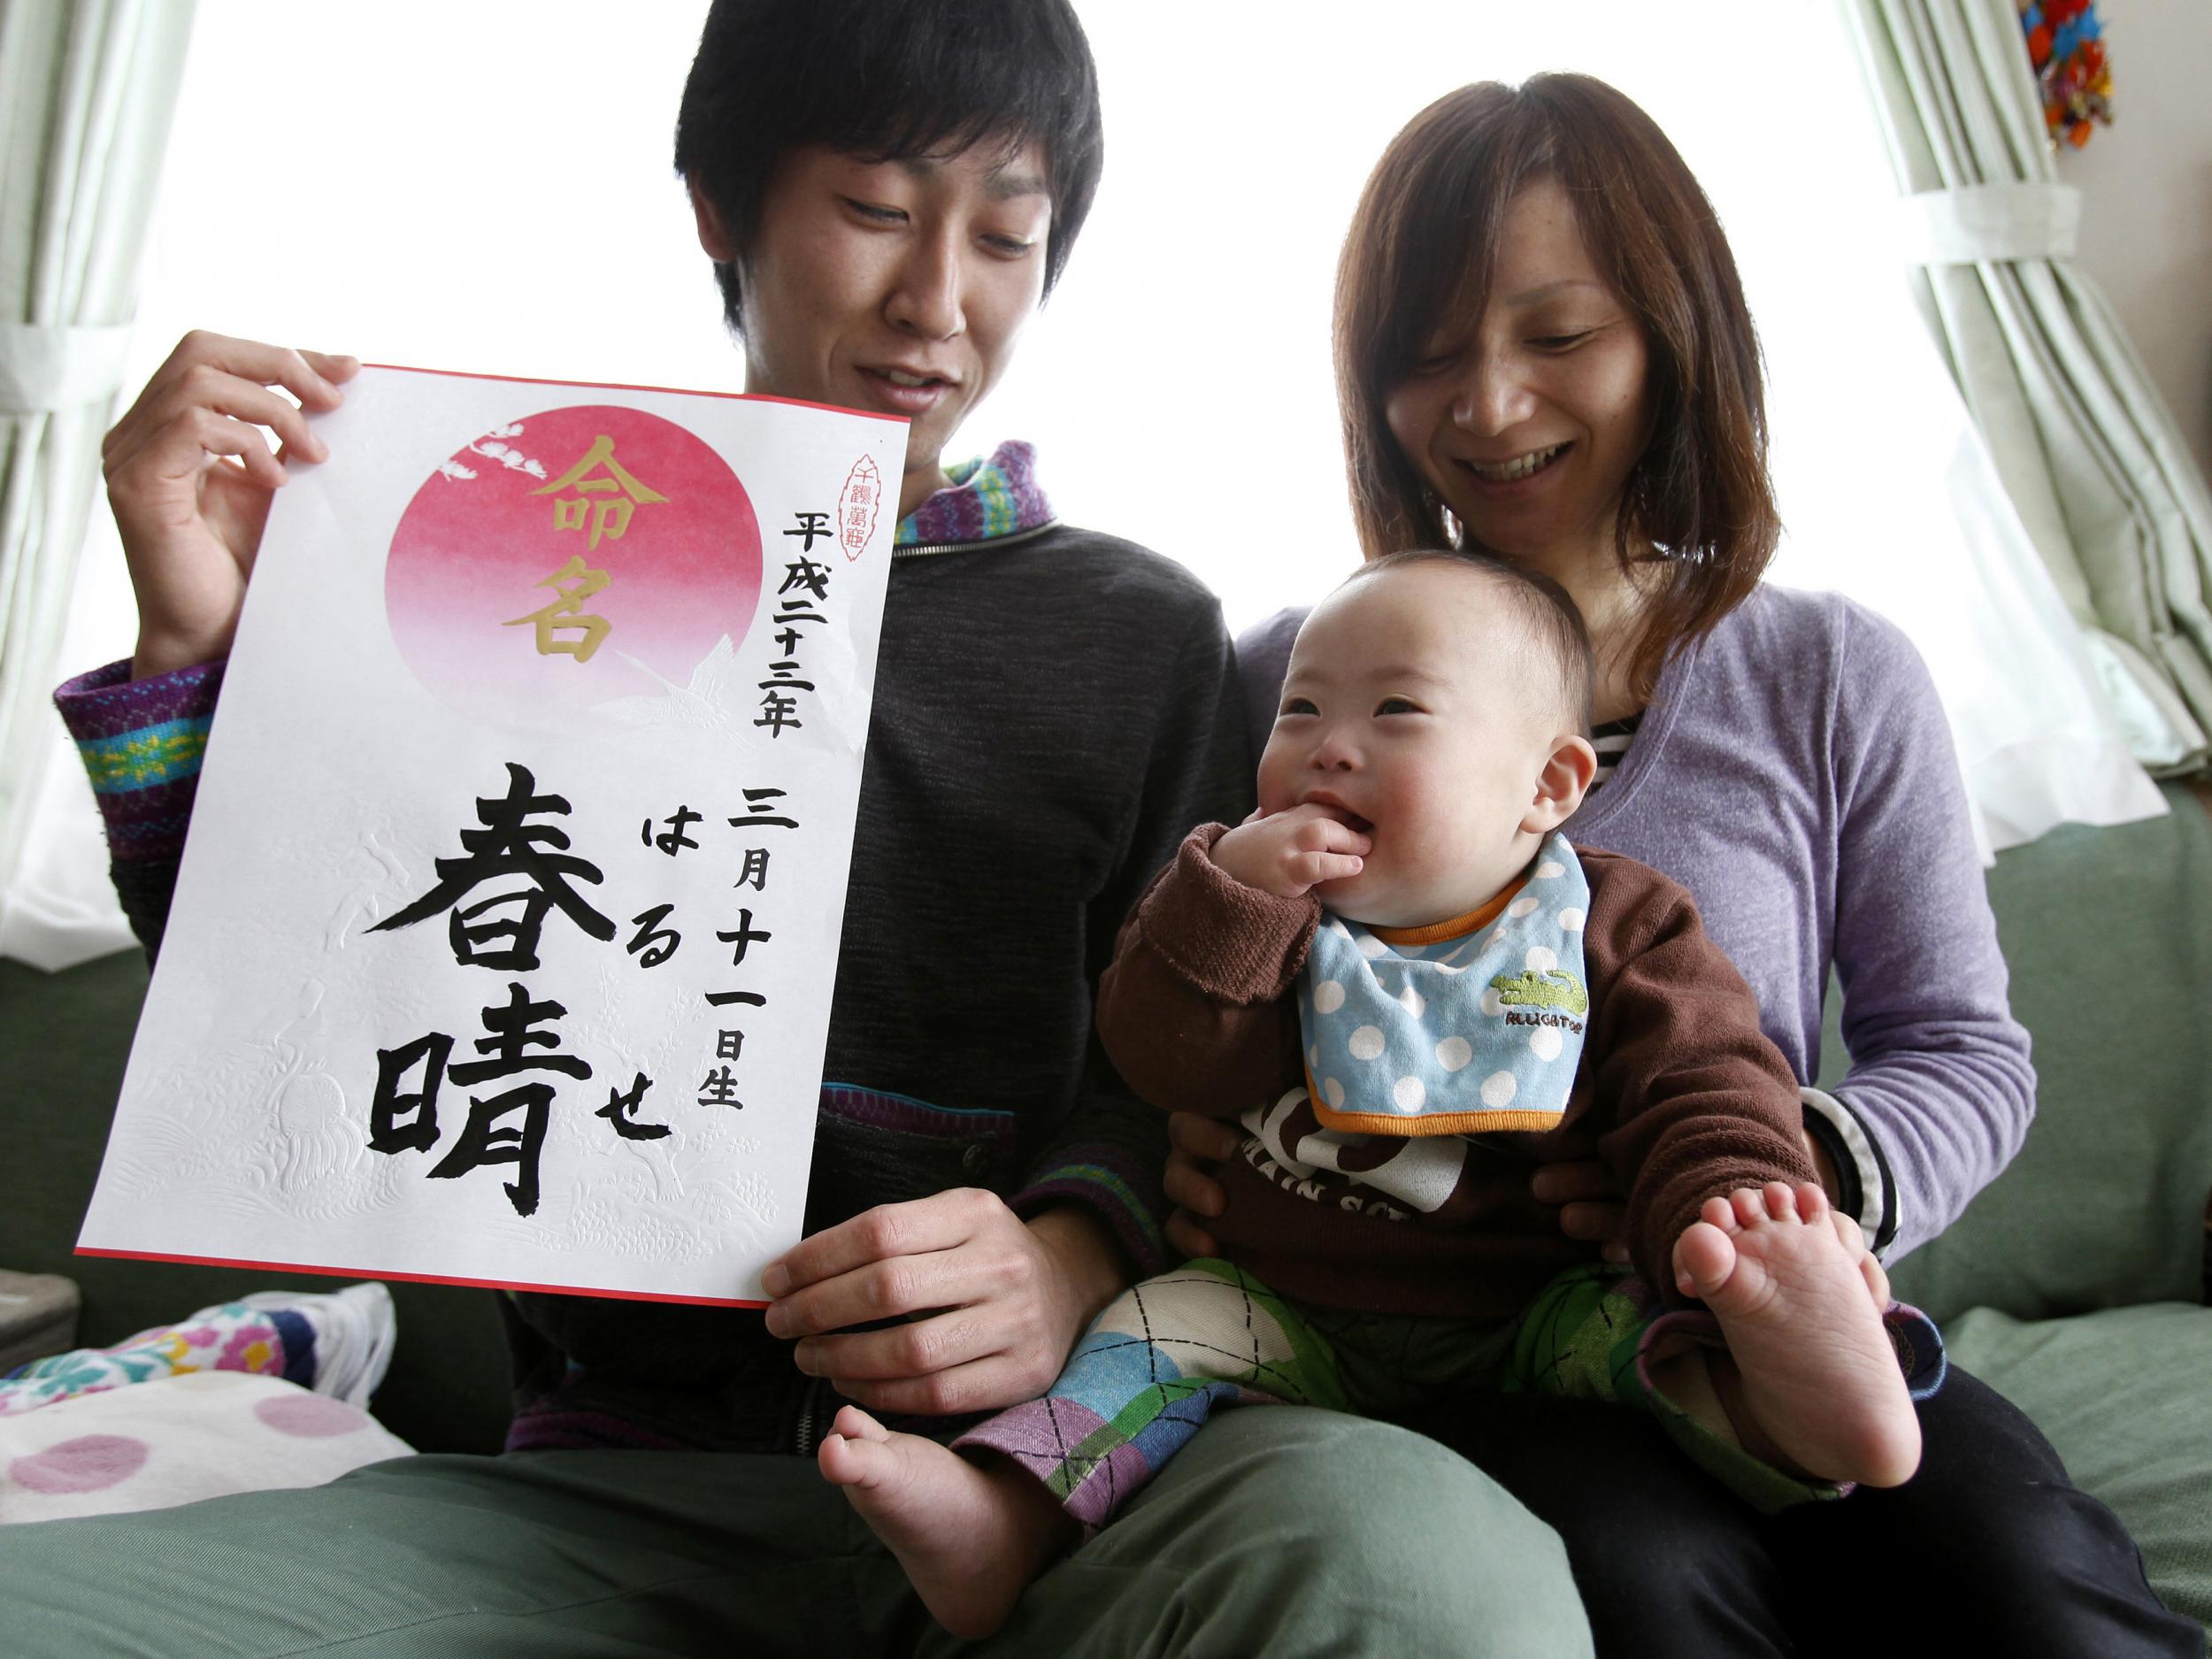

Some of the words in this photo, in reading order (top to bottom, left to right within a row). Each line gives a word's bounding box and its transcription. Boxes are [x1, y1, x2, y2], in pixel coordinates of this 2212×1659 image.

[502, 434, 671, 664] 命名
[753, 511, 834, 739] 平成二十三年
[361, 762, 617, 1217] 春晴
[595, 804, 704, 1141] はるせ
[697, 787, 800, 1110] 三月十一日生
